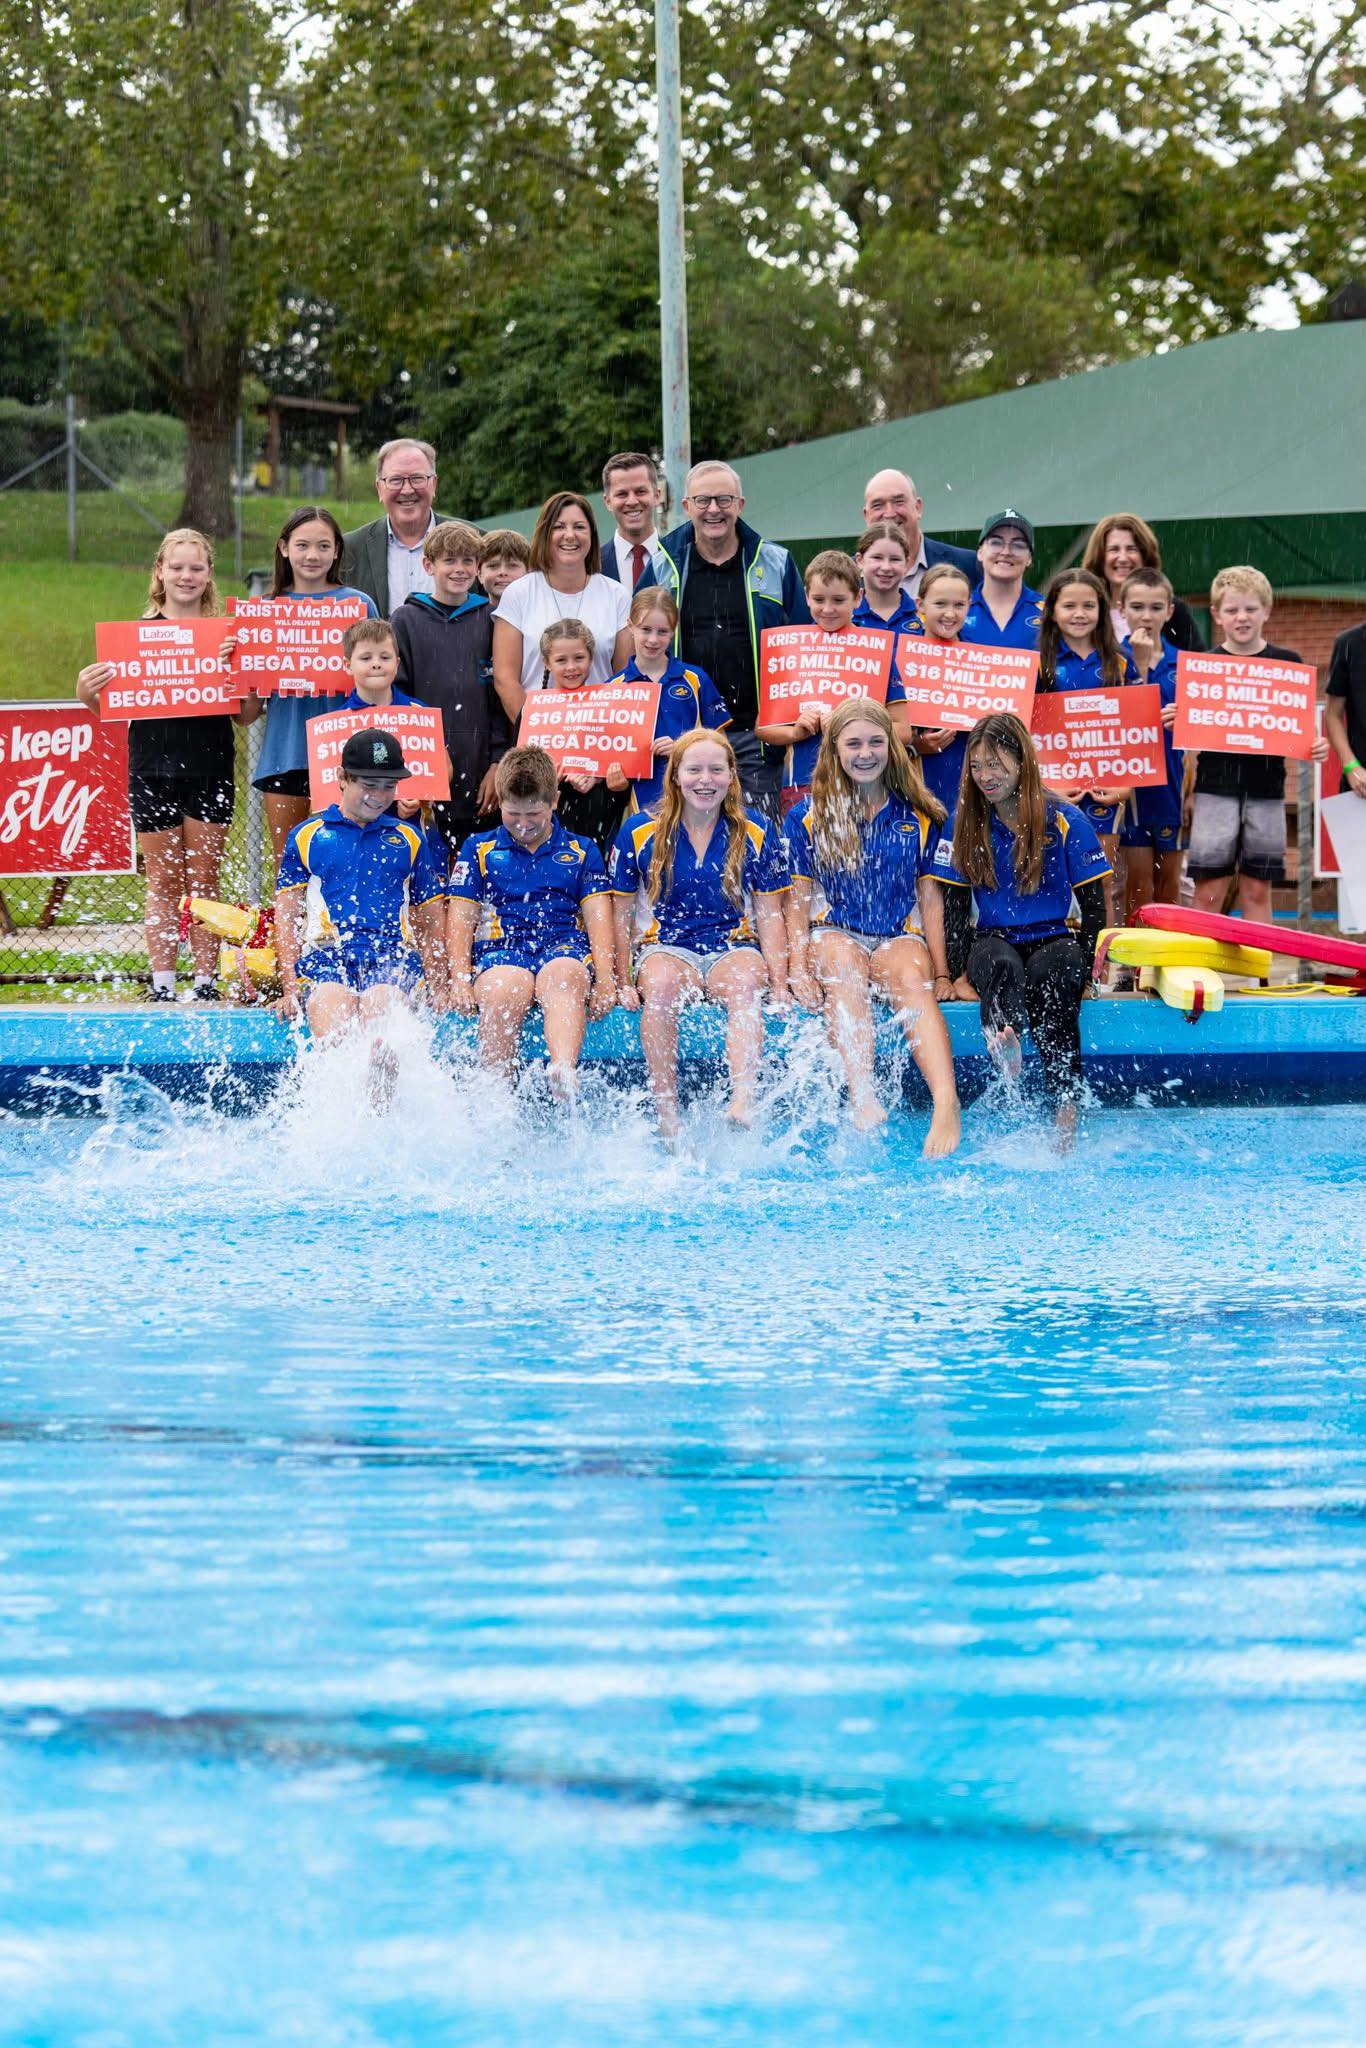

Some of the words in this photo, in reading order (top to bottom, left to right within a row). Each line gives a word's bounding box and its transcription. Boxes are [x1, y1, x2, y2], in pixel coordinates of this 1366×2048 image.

[235, 604, 294, 617] KRISTY
[297, 605, 360, 618] McBAIN
[292, 619, 320, 627] DELIVER
[143, 629, 175, 639] Labor
[237, 627, 273, 645] $16
[276, 628, 346, 645] MILLIO
[767, 632, 820, 648] KRISTY
[822, 632, 887, 651] McBAIN
[139, 649, 159, 657] WILL
[160, 648, 195, 656] DELIVER
[286, 646, 319, 654] UPGRADE
[906, 641, 967, 659] KRISTY
[967, 650, 1032, 669] McBAIN
[240, 655, 295, 671] BEGA
[767, 655, 797, 674] $16
[800, 654, 881, 676] MILLION
[1185, 658, 1247, 676] KRISTY
[1247, 664, 1311, 686] McBAIN
[155, 678, 195, 687] UPGRADE
[904, 661, 941, 680] $16
[943, 668, 1027, 690] MILLION
[108, 689, 167, 708] BEGA
[171, 687, 230, 705] POOL
[532, 691, 588, 705] KRISTY
[588, 688, 650, 702] McBAIN
[769, 680, 814, 700] BEGA
[904, 686, 960, 708] BEGA
[962, 695, 1019, 713] POOL
[1186, 680, 1224, 699] $16
[1226, 685, 1308, 710] MILLION
[1068, 700, 1099, 711] Labor
[314, 714, 371, 736] KRISTY
[373, 713, 436, 729] McBAIN
[528, 711, 562, 727] $16
[565, 709, 646, 726] MILLION
[1188, 708, 1245, 728] BEGA
[1247, 713, 1303, 735] POOL
[11, 723, 94, 763] keep
[527, 734, 580, 750] BEGA
[584, 734, 638, 752] POOL
[1071, 726, 1159, 749] MILLION
[1068, 751, 1080, 759] TO
[1097, 757, 1157, 778] POOL
